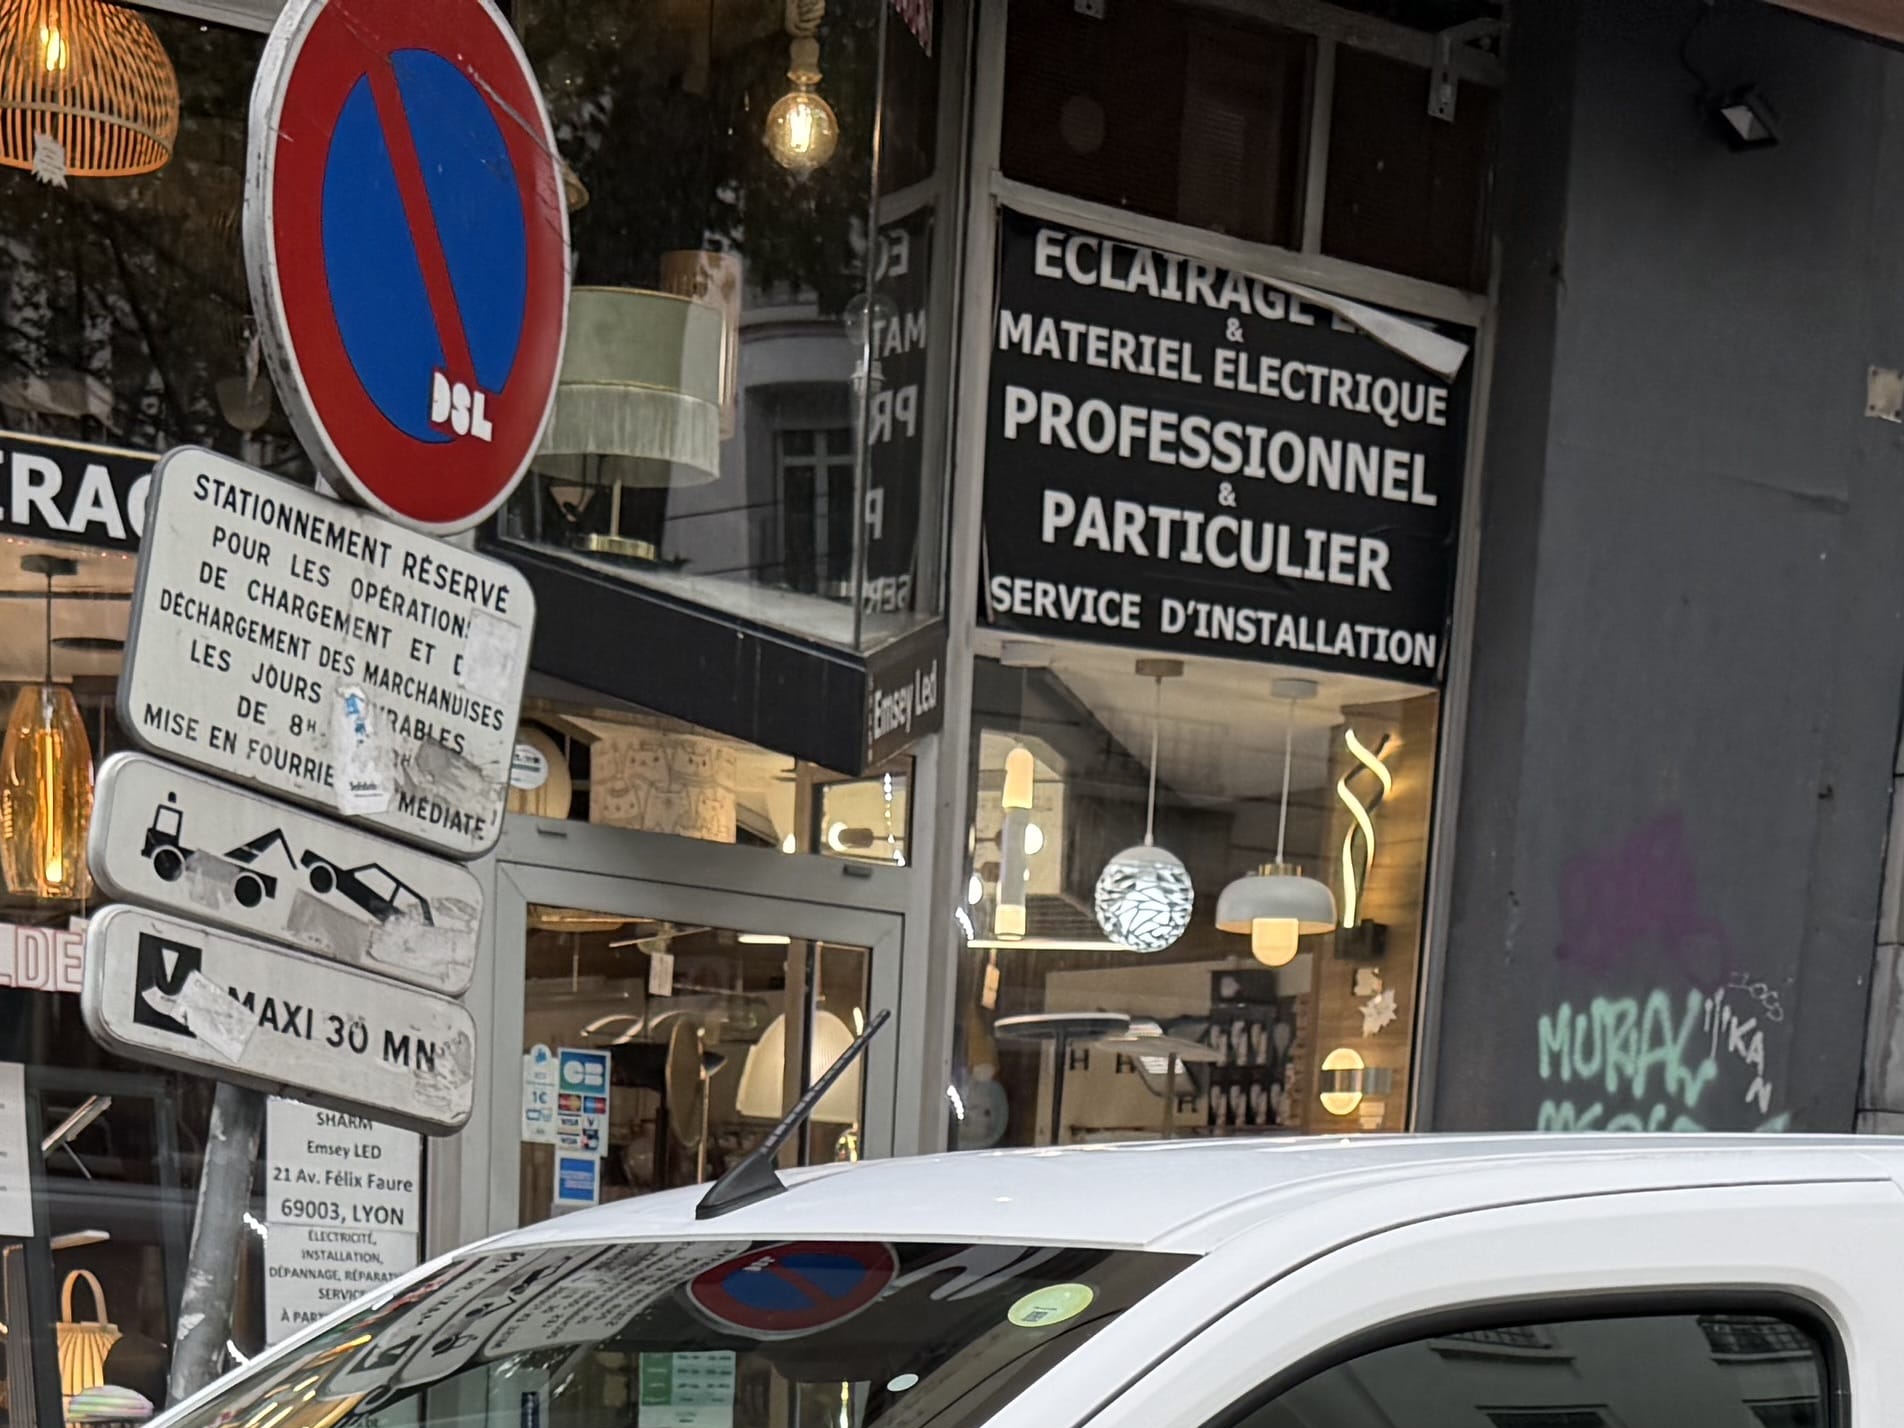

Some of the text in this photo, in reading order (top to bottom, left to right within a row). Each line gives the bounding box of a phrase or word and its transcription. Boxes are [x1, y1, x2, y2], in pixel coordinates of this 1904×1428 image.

[1225, 316, 1244, 343] &
[998, 309, 1449, 428] MATERIEL ELECTRIQUE
[431, 371, 493, 442] DSL
[1003, 385, 1438, 507] PROFESSIONNEL
[1218, 481, 1237, 508] &
[193, 473, 511, 614] STATIONNEMENT RÉSERVÉ
[212, 525, 272, 568] POUR
[290, 553, 332, 588] LES
[1041, 490, 1393, 592] PARTICULIER
[199, 560, 227, 591] DE
[247, 579, 393, 650] CHARGEMENT
[410, 638, 437, 667] ET
[990, 574, 1437, 669] SERVICE D'INSTALLATION
[159, 587, 505, 733] DÉCHARGEMENT DES MARCHANDISES
[190, 638, 232, 673] LES
[251, 661, 323, 704] JOURS
[237, 695, 268, 726] DE
[143, 703, 487, 843] MISE EN FOURRIE MÉDIATE
[325, 1014, 370, 1056] 30
[382, 1029, 437, 1073] MN
[273, 1166, 414, 1193] 21 Av. Félix Faure
[307, 1140, 382, 1160] Emsey LED
[281, 1198, 405, 1226] 69003, LYON
